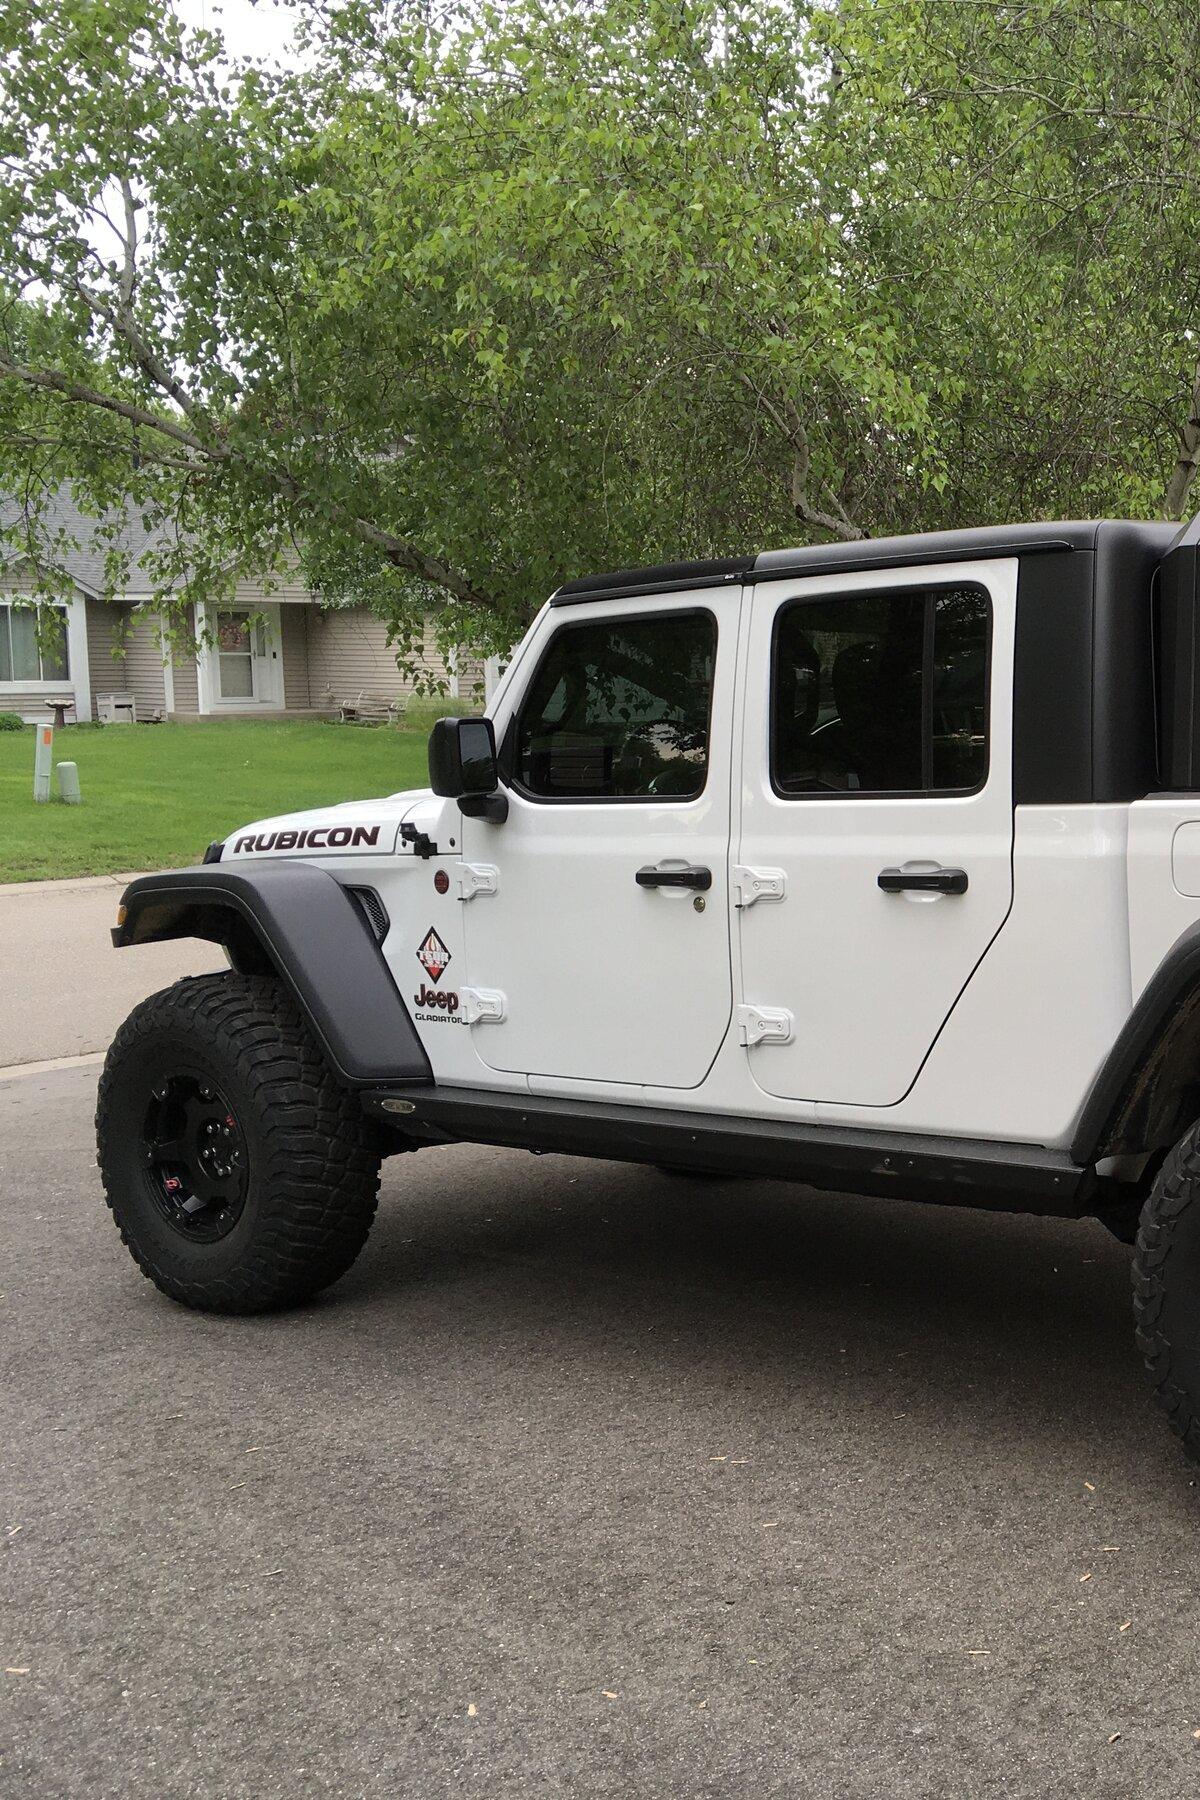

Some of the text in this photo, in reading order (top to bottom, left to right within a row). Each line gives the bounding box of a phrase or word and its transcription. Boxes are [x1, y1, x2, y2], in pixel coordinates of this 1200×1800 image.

[233, 826, 381, 853] RUBICON
[413, 984, 459, 1014] Jeep
[414, 1013, 463, 1024] GLADIATOR
